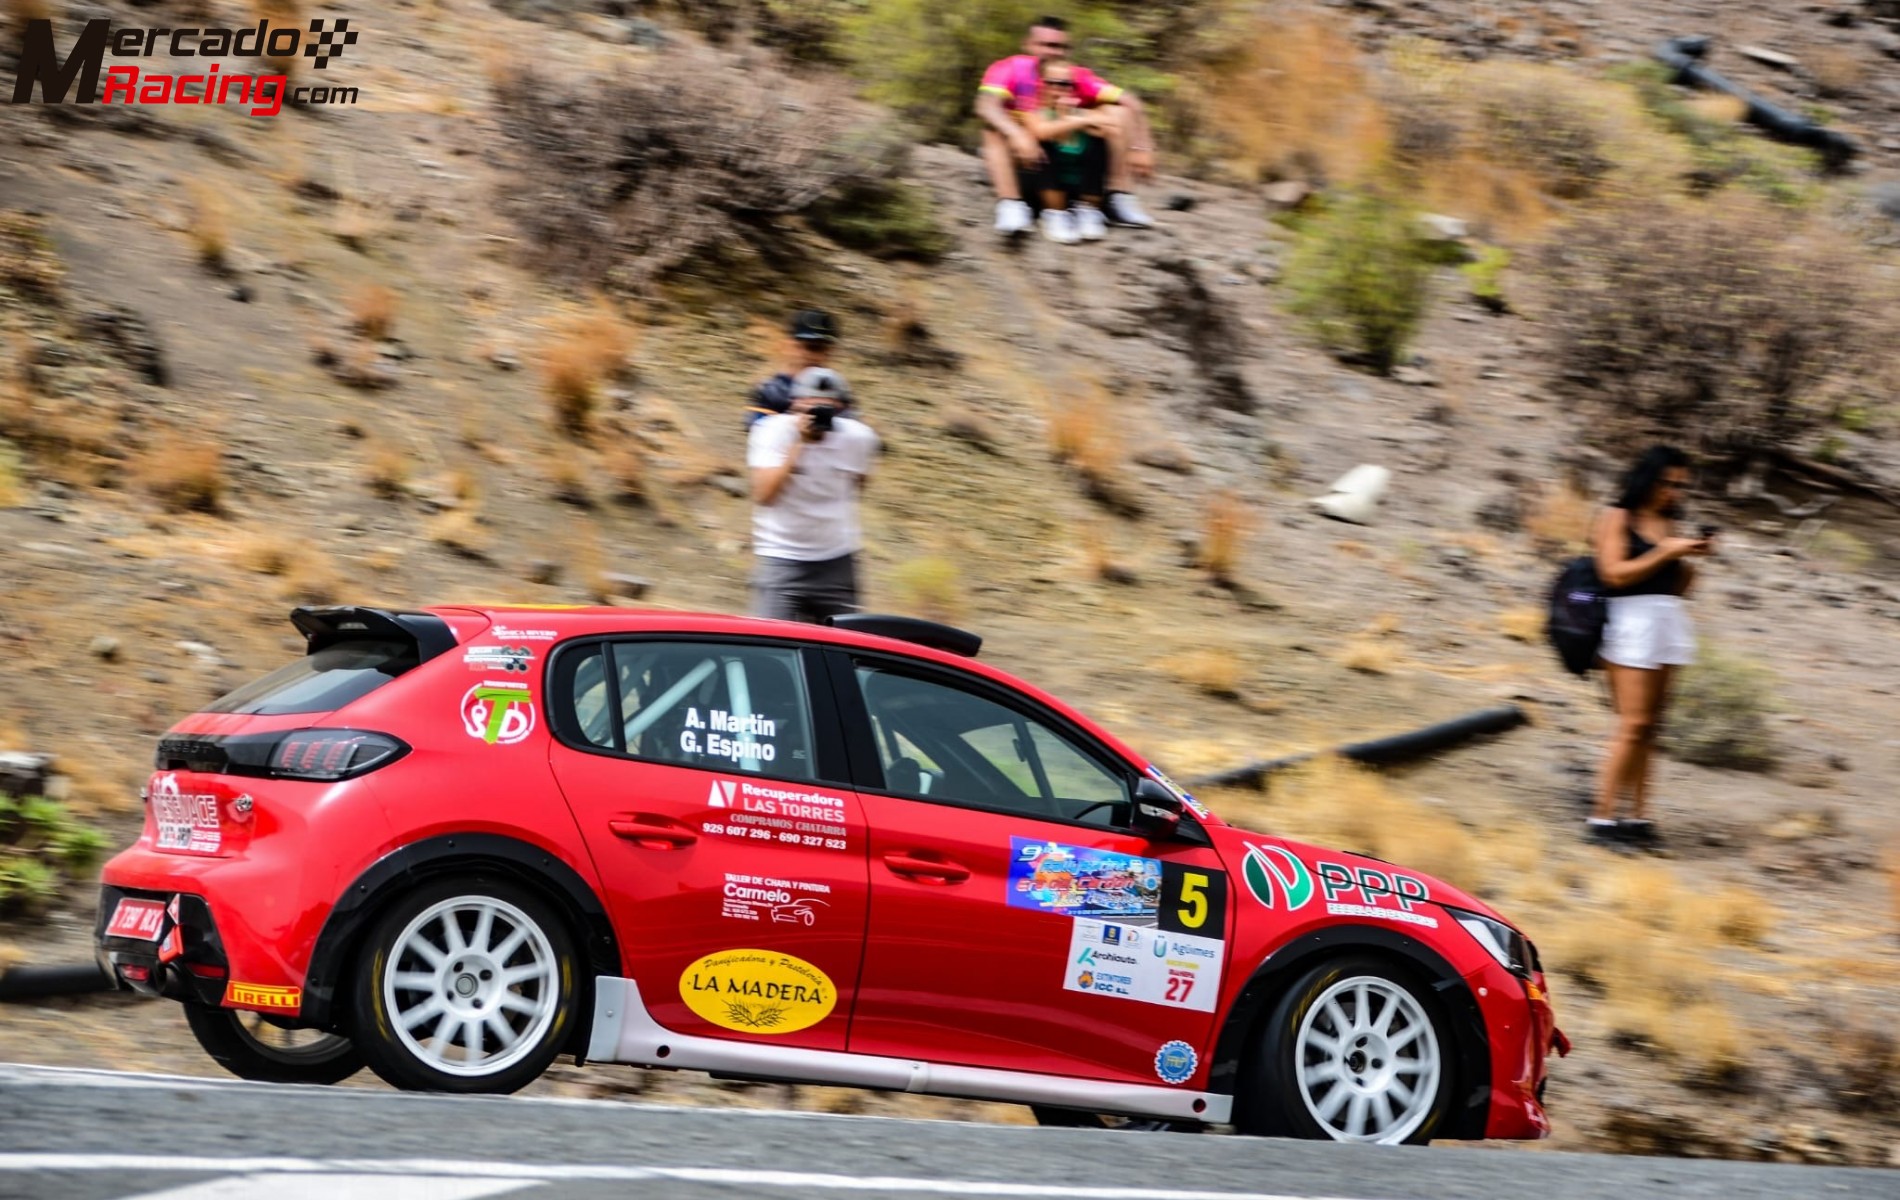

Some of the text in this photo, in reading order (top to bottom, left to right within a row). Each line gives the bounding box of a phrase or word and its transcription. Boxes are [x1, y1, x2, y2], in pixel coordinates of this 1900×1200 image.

[685, 707, 775, 736] A. Martín
[680, 731, 702, 752] G.
[707, 733, 775, 761] Espino
[742, 783, 844, 807] Recuperadora
[744, 798, 845, 823] LAS TORRES
[702, 822, 724, 834] 928
[726, 826, 747, 837] 607
[749, 829, 771, 840] 296
[779, 832, 800, 844] 690
[802, 835, 823, 847] 327
[730, 813, 847, 836] COMPRAMOS CHATARRA
[723, 882, 791, 903] Carmelo
[724, 873, 751, 884] TALLER
[752, 876, 764, 885] DE
[765, 878, 791, 889] CHAPA
[1317, 861, 1429, 912] PPP
[1177, 872, 1208, 928] 5
[704, 954, 766, 970] Panificadora
[1171, 942, 1215, 959] Agüimes
[227, 982, 300, 1006] PIRELLI
[693, 974, 822, 1004] LA MADERA
[1094, 983, 1114, 993] ICC
[1165, 977, 1194, 1003] 27
